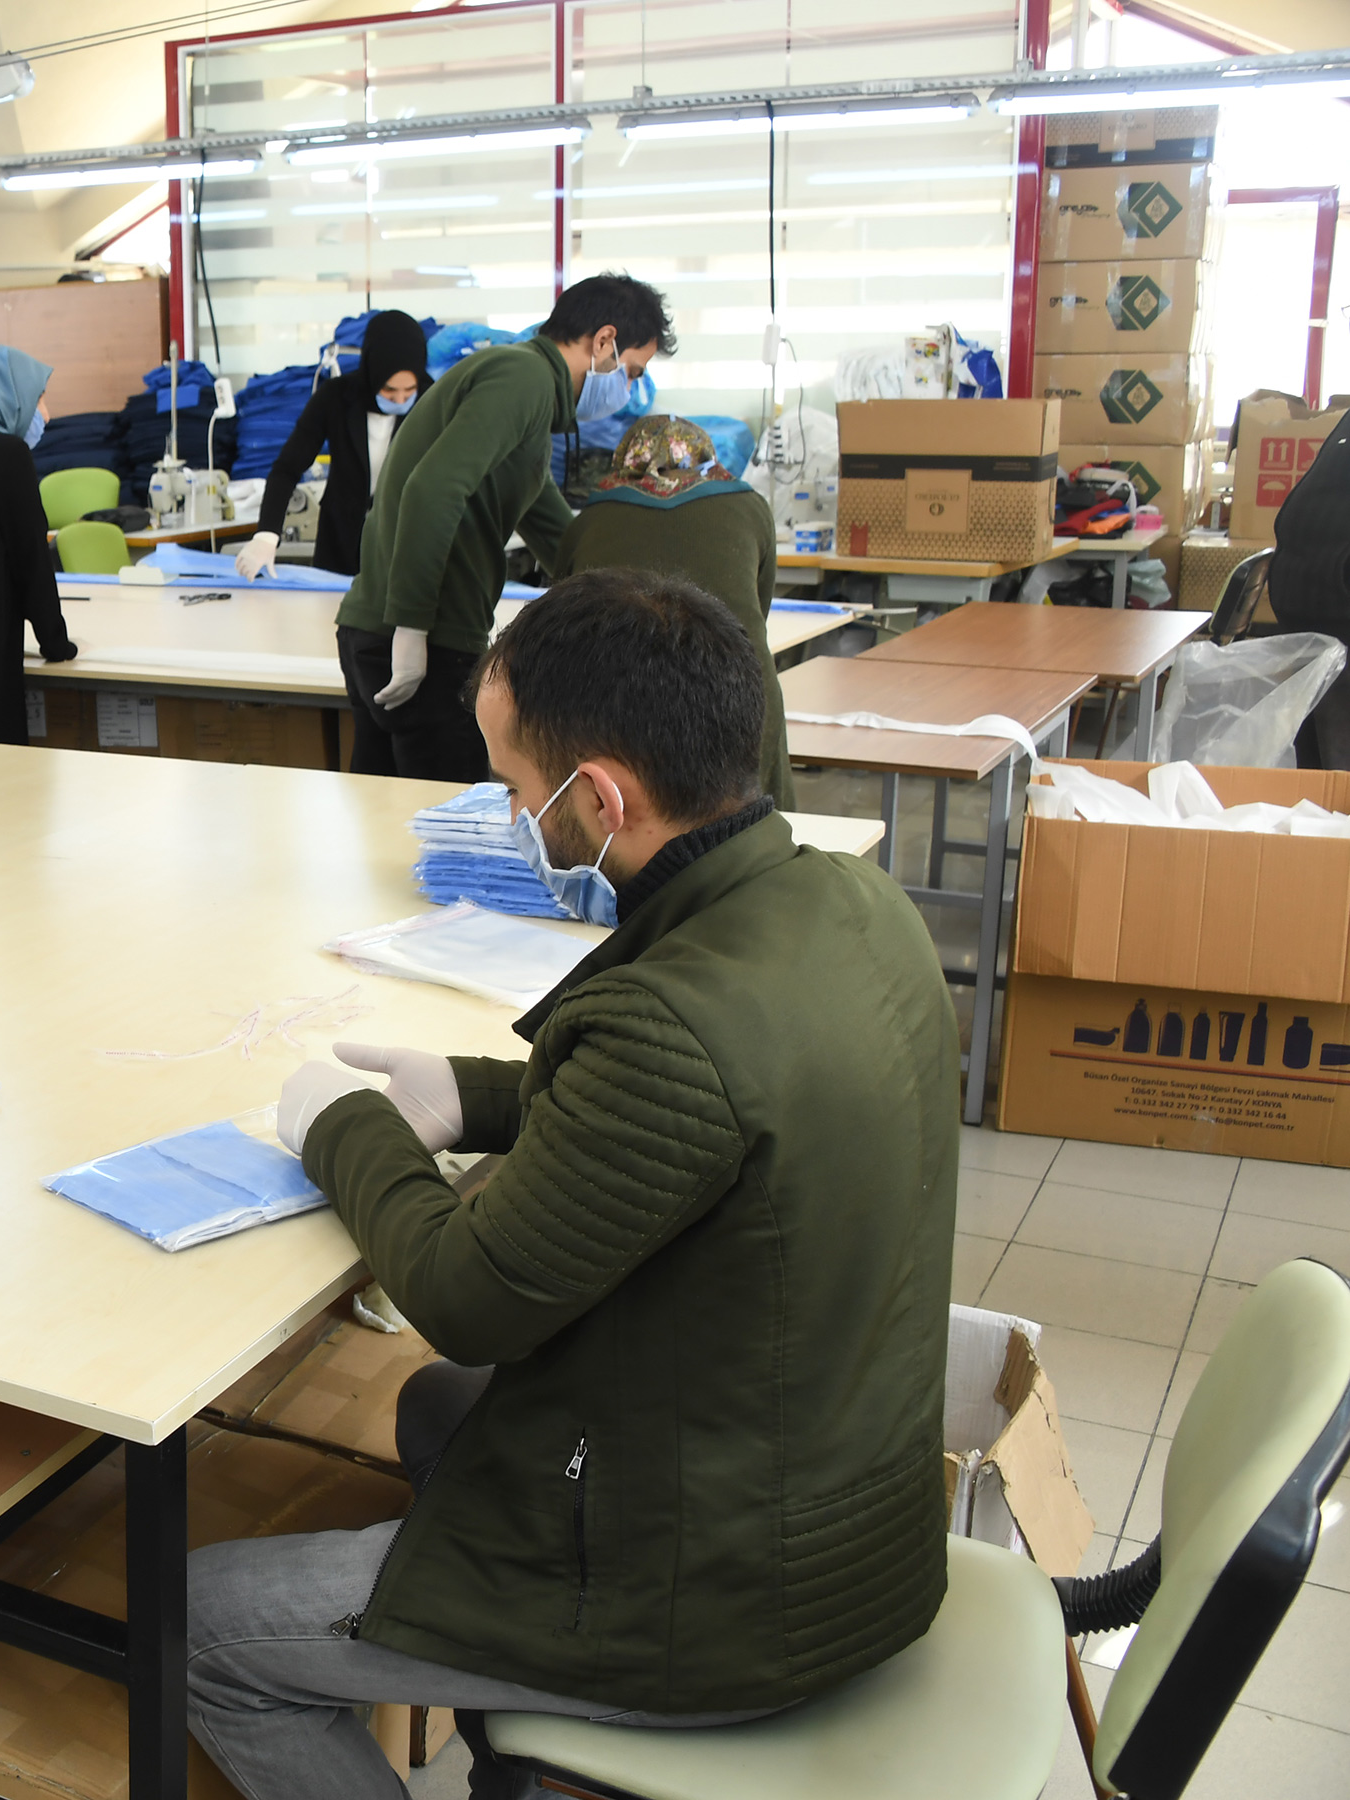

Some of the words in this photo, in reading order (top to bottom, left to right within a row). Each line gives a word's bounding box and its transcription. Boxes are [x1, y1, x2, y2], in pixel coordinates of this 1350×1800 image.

[1110, 1073, 1129, 1083] Özel
[1131, 1076, 1168, 1087] Organize
[1170, 1080, 1198, 1090] Sanayi
[1232, 1087, 1255, 1096] Fevzi
[1291, 1092, 1336, 1104] Mahallesi
[1159, 1099, 1175, 1109] 342
[1189, 1102, 1201, 1111] 79
[1245, 1108, 1261, 1118] 342
[1161, 1090, 1186, 1100] Sokak
[1210, 1095, 1243, 1106] Karatay
[1252, 1099, 1283, 1109] KONYA
